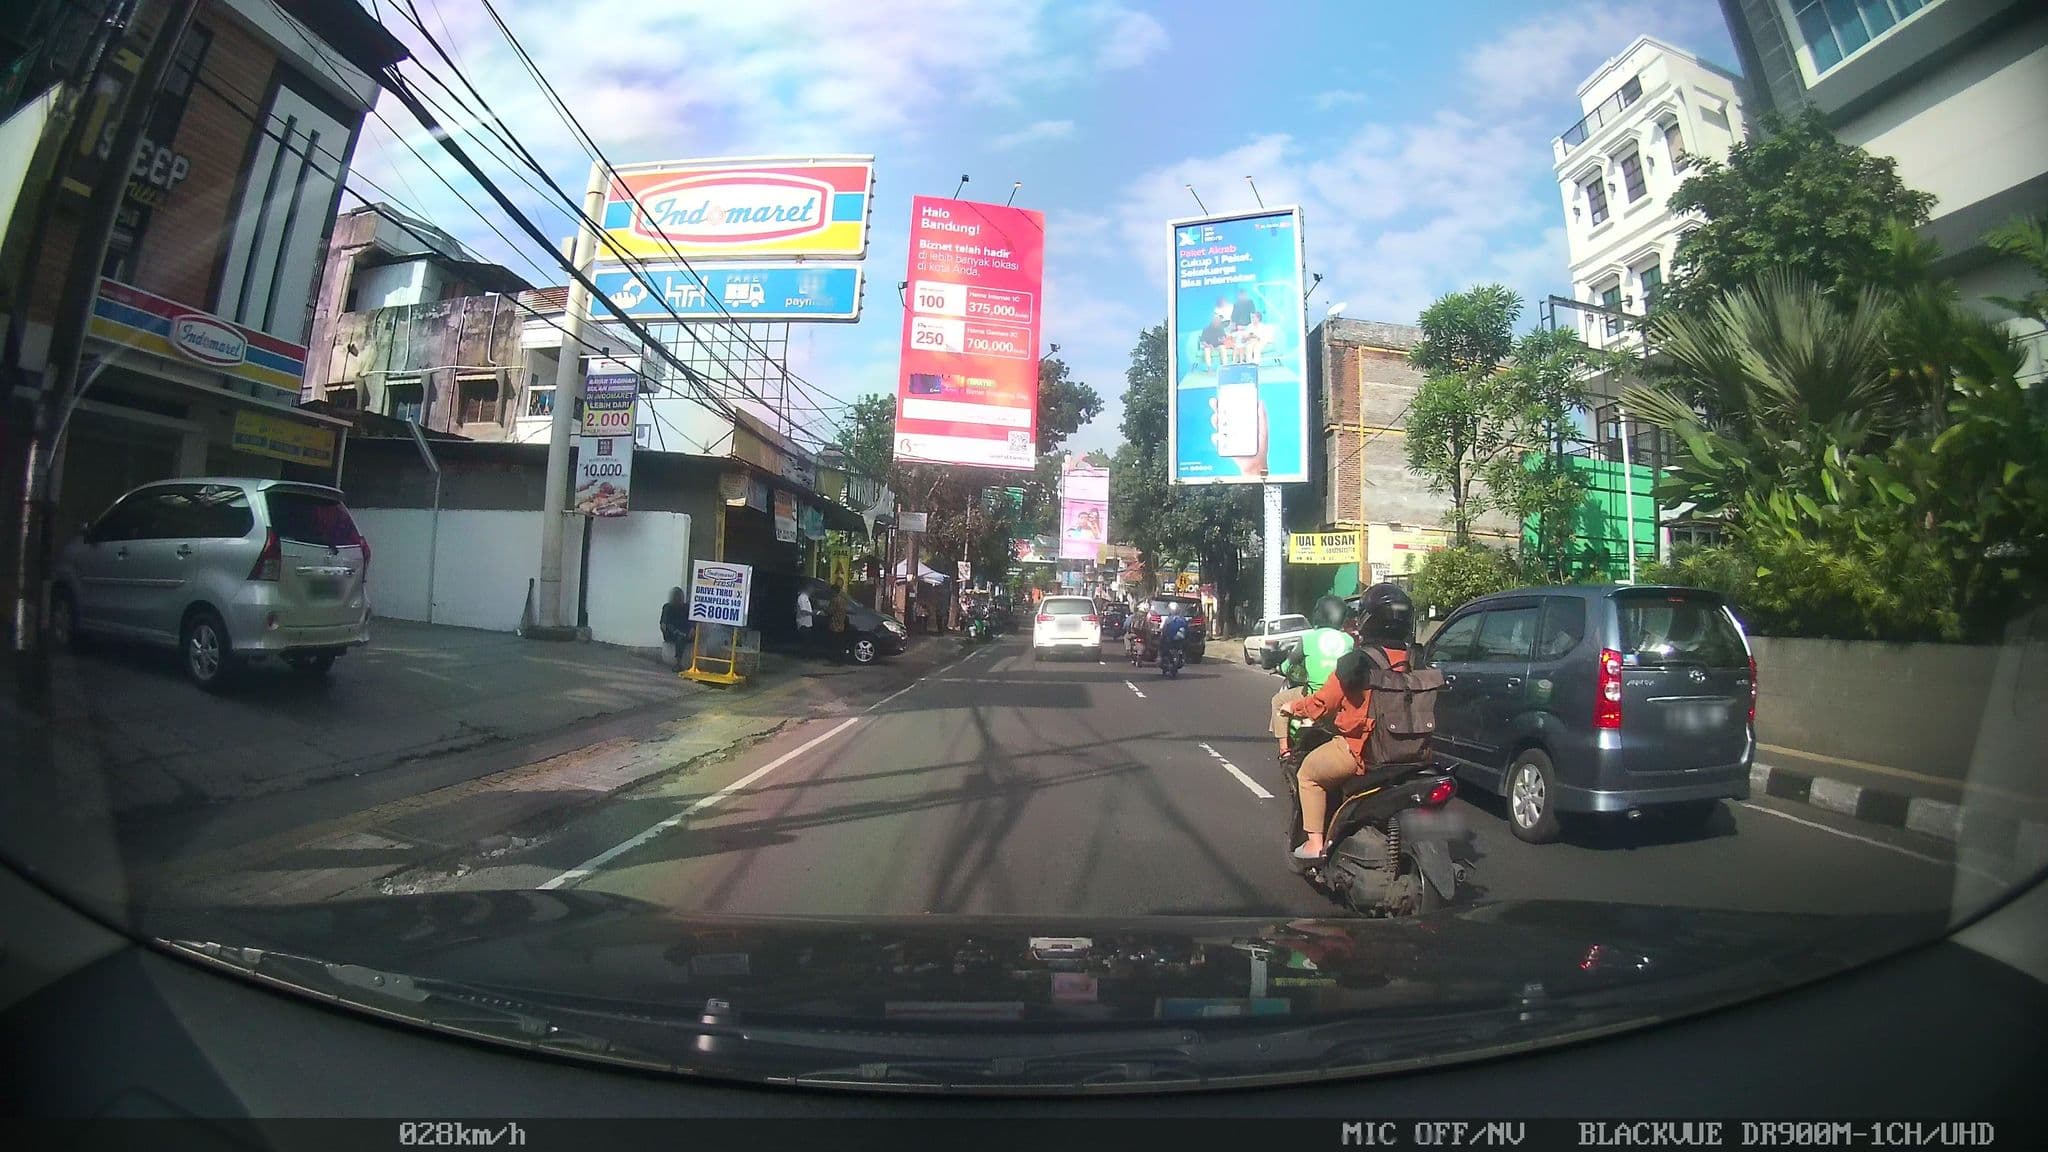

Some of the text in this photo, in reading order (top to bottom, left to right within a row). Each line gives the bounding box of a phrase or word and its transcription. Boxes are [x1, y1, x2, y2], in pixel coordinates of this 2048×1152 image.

[645, 196, 816, 226] Indomaret
[922, 206, 950, 219] Halo
[921, 218, 980, 236] Bandung!
[920, 239, 1010, 259] Biznet telah hadir
[956, 254, 990, 268] banyak
[992, 258, 1019, 271] lokasi
[920, 294, 945, 309] 100
[969, 302, 1016, 317] 375,000
[182, 324, 241, 357] Indomaret
[916, 330, 944, 345] 250
[612, 401, 630, 409] DARI
[587, 412, 630, 427] 2.000
[584, 463, 622, 477] 10.000
[1320, 534, 1355, 546] KOSAN
[696, 586, 733, 597] DRIVE THRU
[713, 580, 736, 588] Fresh
[708, 606, 739, 621] 800M
